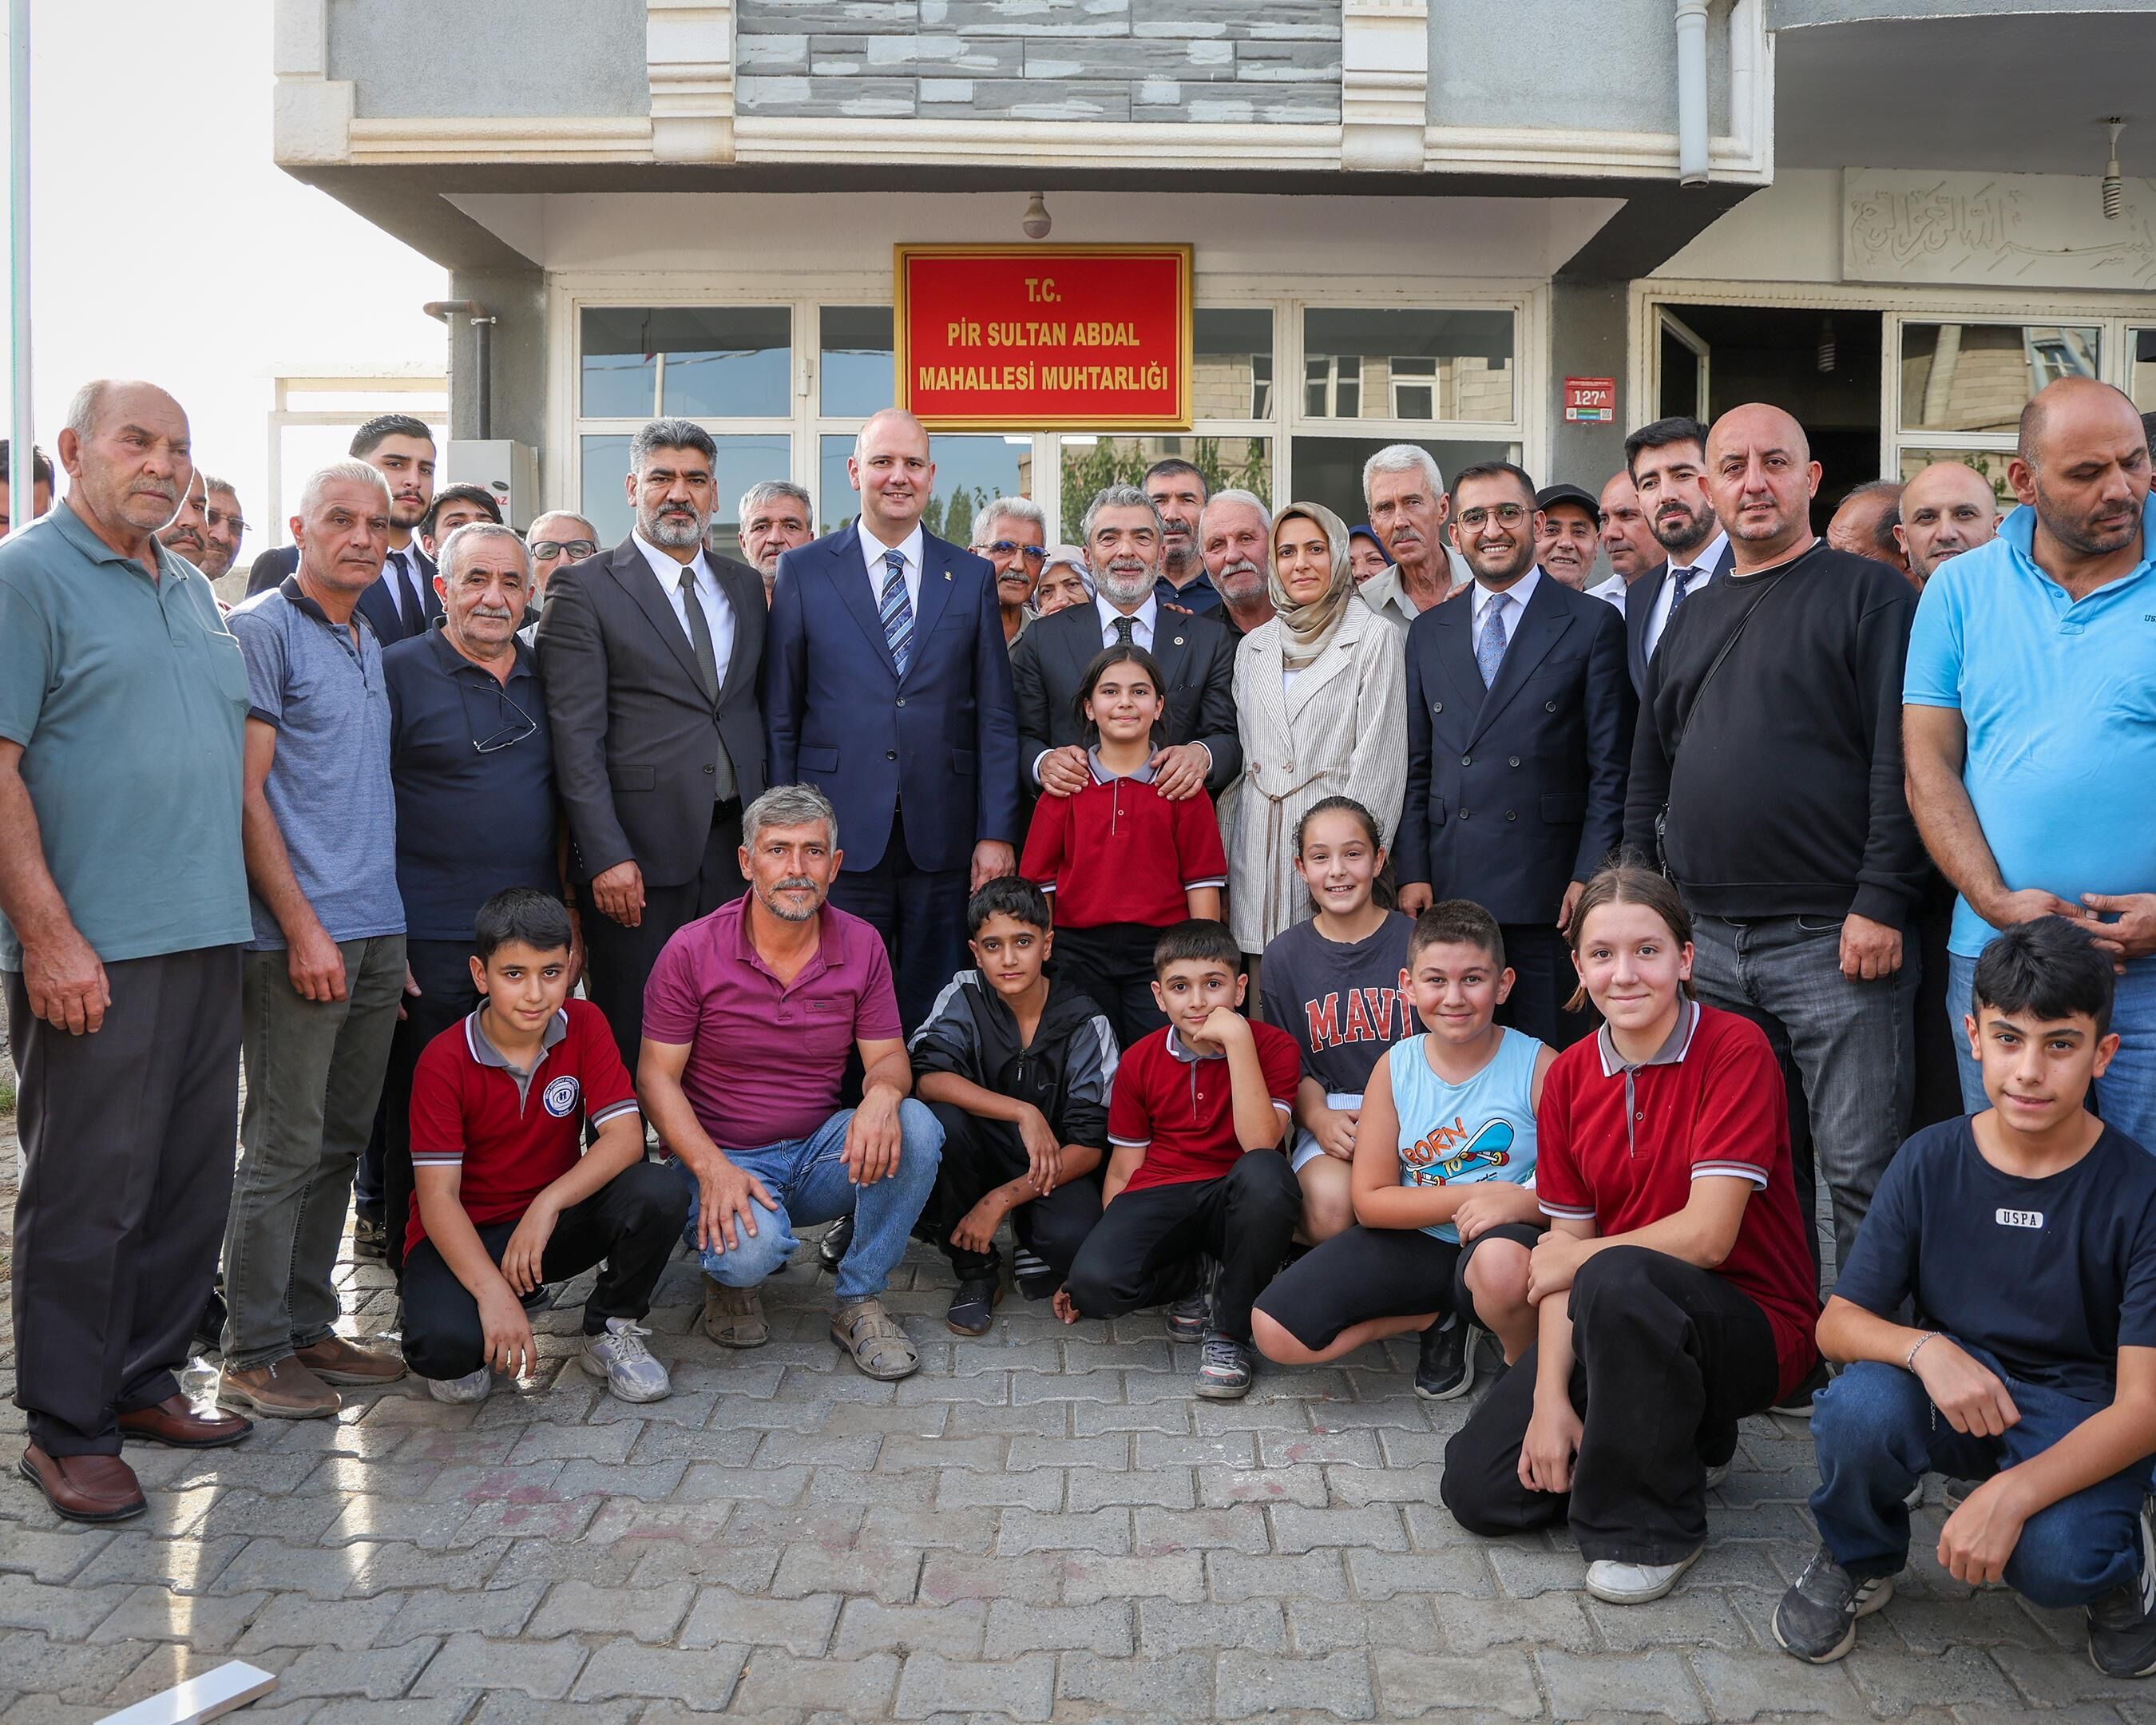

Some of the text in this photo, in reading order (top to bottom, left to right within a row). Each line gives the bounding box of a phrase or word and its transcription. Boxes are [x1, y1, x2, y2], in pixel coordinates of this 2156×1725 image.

[1025, 278, 1061, 302] T.C.
[948, 317, 1140, 346] PİR SULTAN ABDAL
[919, 360, 1168, 391] MAHALLESİ MUHTARLIĞI
[1402, 1116, 1468, 1165] BORN
[1443, 1157, 1462, 1177] TO
[2003, 1211, 2037, 1226] USPA
